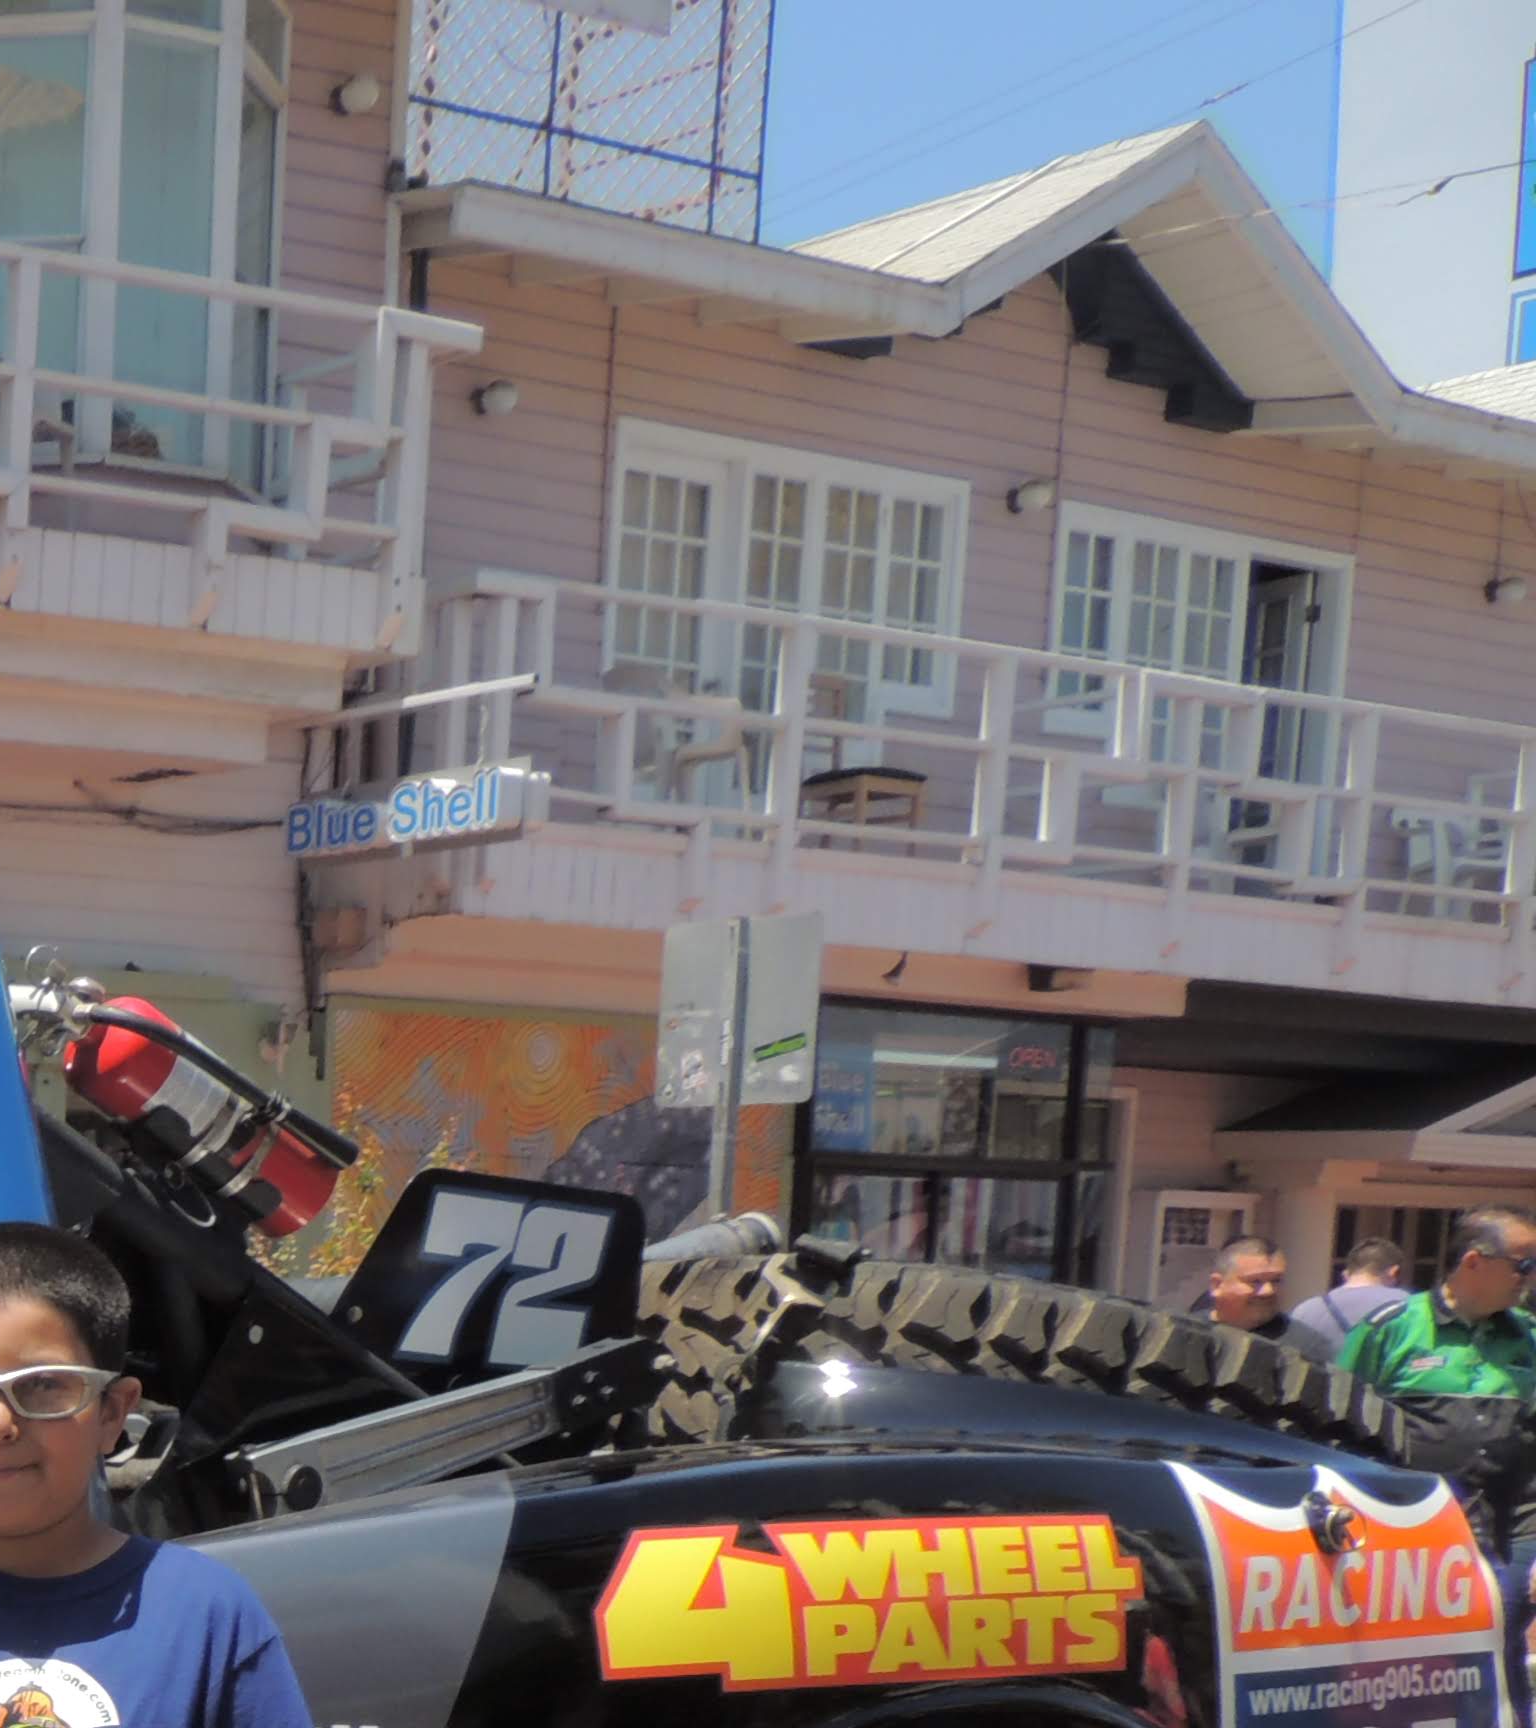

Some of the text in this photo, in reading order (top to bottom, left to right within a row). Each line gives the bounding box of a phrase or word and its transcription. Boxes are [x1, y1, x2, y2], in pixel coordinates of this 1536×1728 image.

[285, 767, 503, 854] Blue Shell
[391, 1183, 616, 1368] 72
[602, 1524, 1137, 1682] 4 WHEEL
[1239, 1543, 1474, 1634] RACING
[802, 1593, 1124, 1677] PARTS
[1248, 1661, 1482, 1716] www.racing905.com
